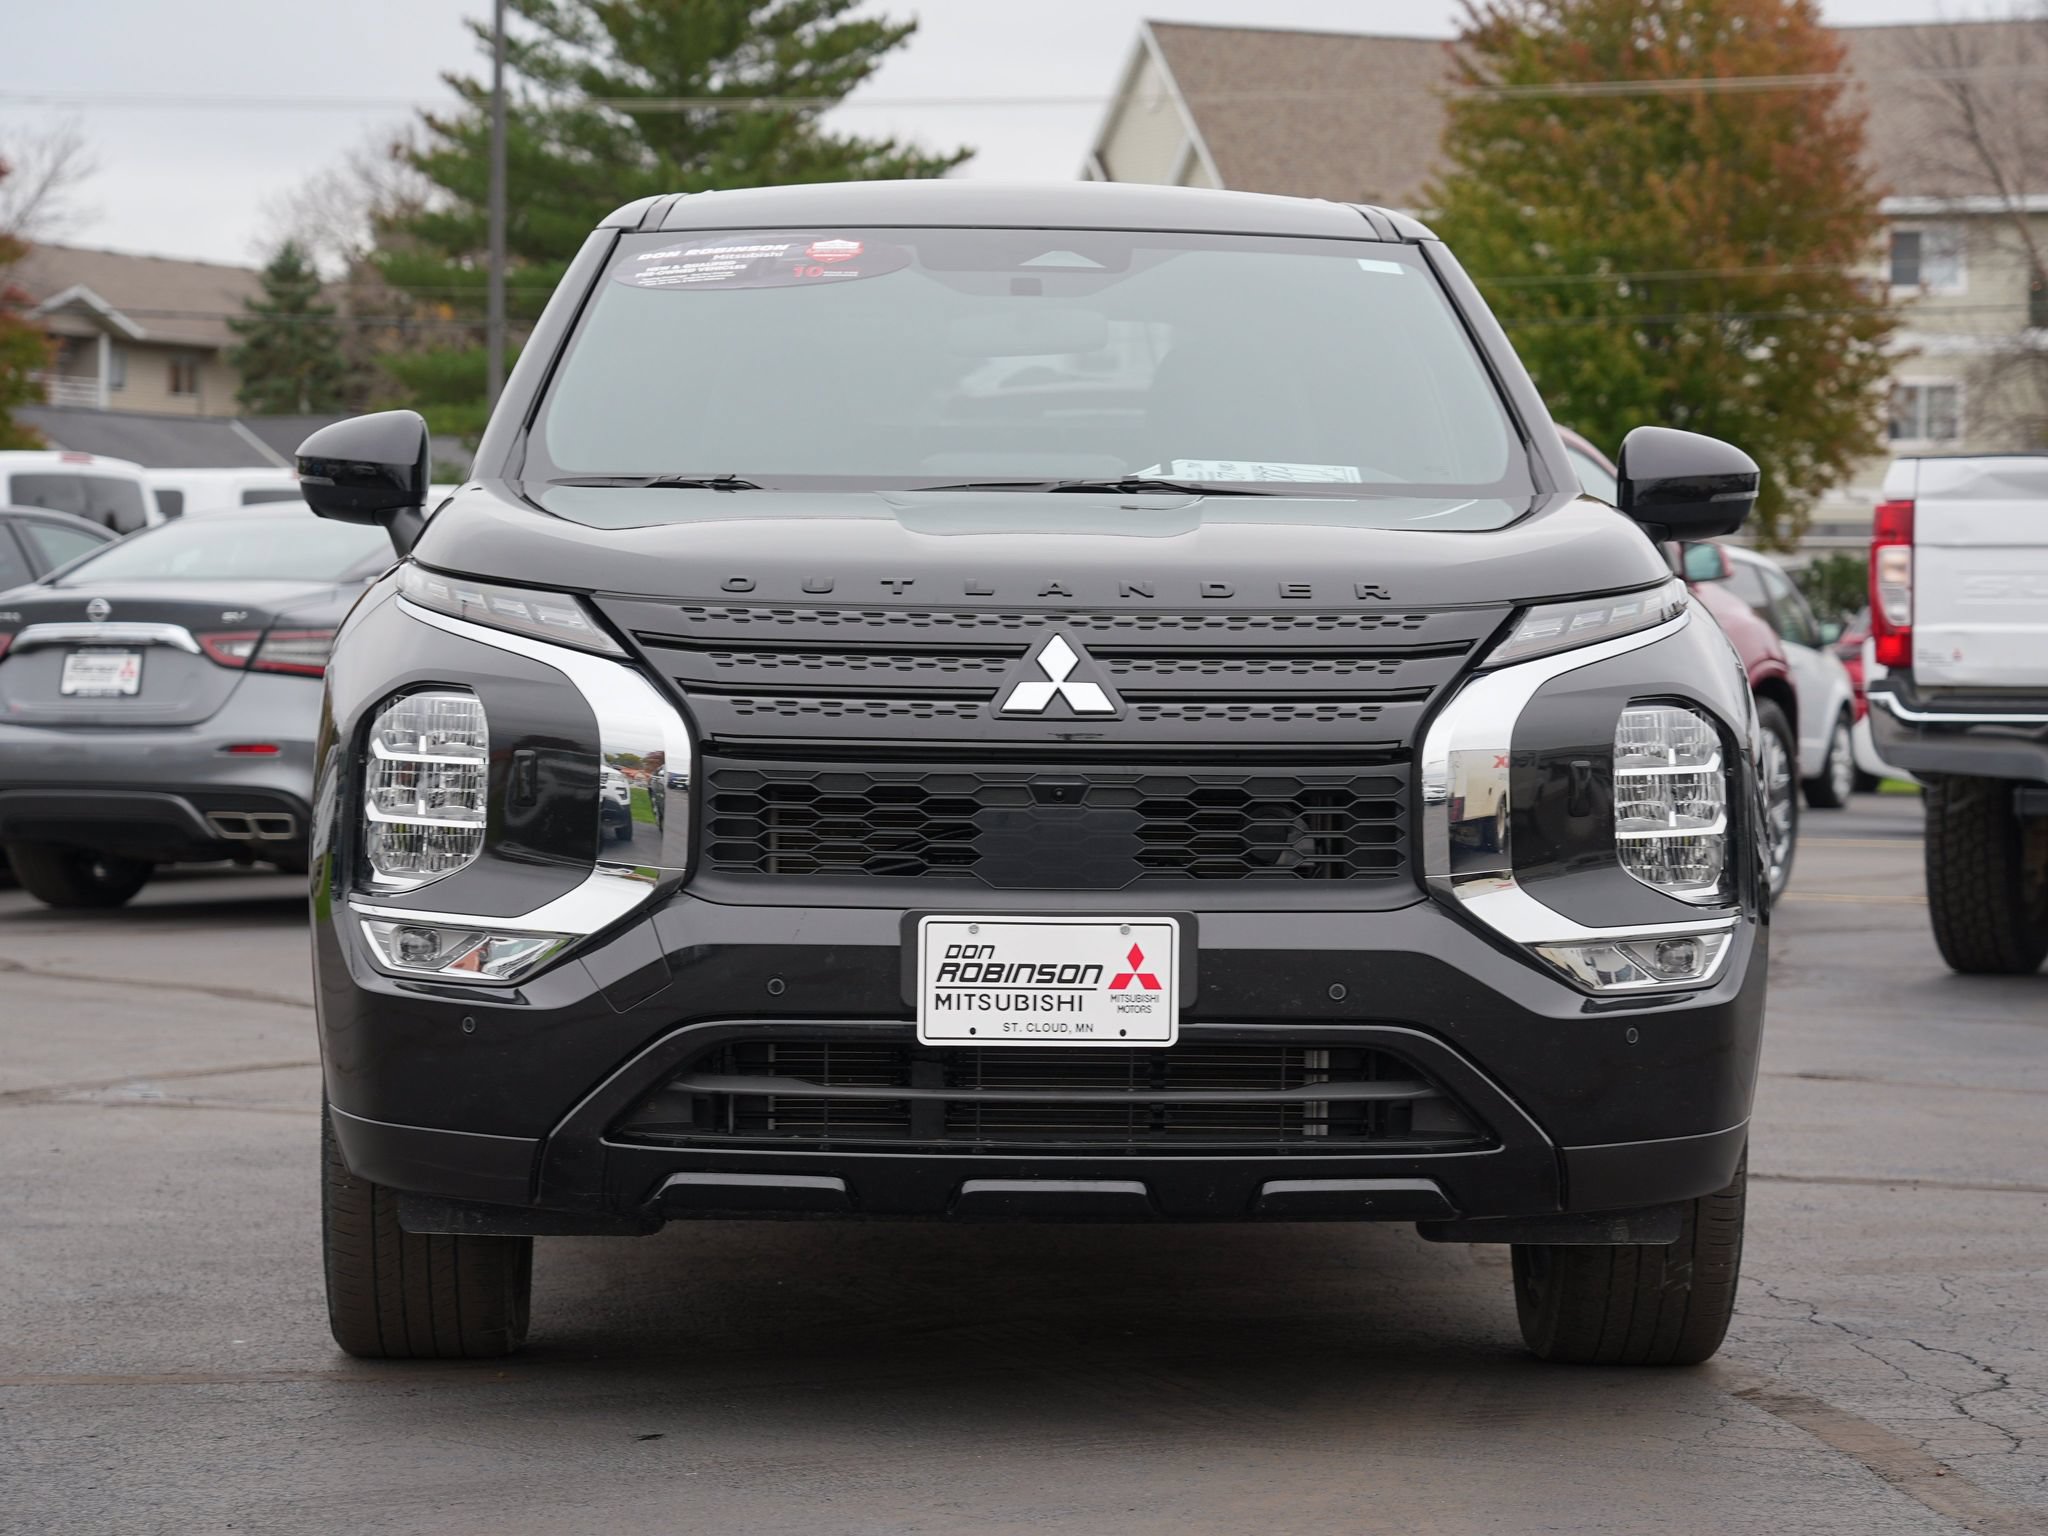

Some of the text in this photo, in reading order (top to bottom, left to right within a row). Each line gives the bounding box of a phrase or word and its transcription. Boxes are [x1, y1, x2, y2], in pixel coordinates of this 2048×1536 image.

[712, 251, 784, 260] Mitsubishi
[720, 577, 1391, 600] OUTLANDER
[945, 944, 995, 959] DON
[936, 962, 1104, 984] ROBINSON
[935, 993, 1083, 1012] MITSUBISHI
[1110, 994, 1160, 1003] MITSUBISHI
[1117, 1004, 1153, 1014] MOTORS
[1002, 1022, 1094, 1034] ST. CLOUD, MN
